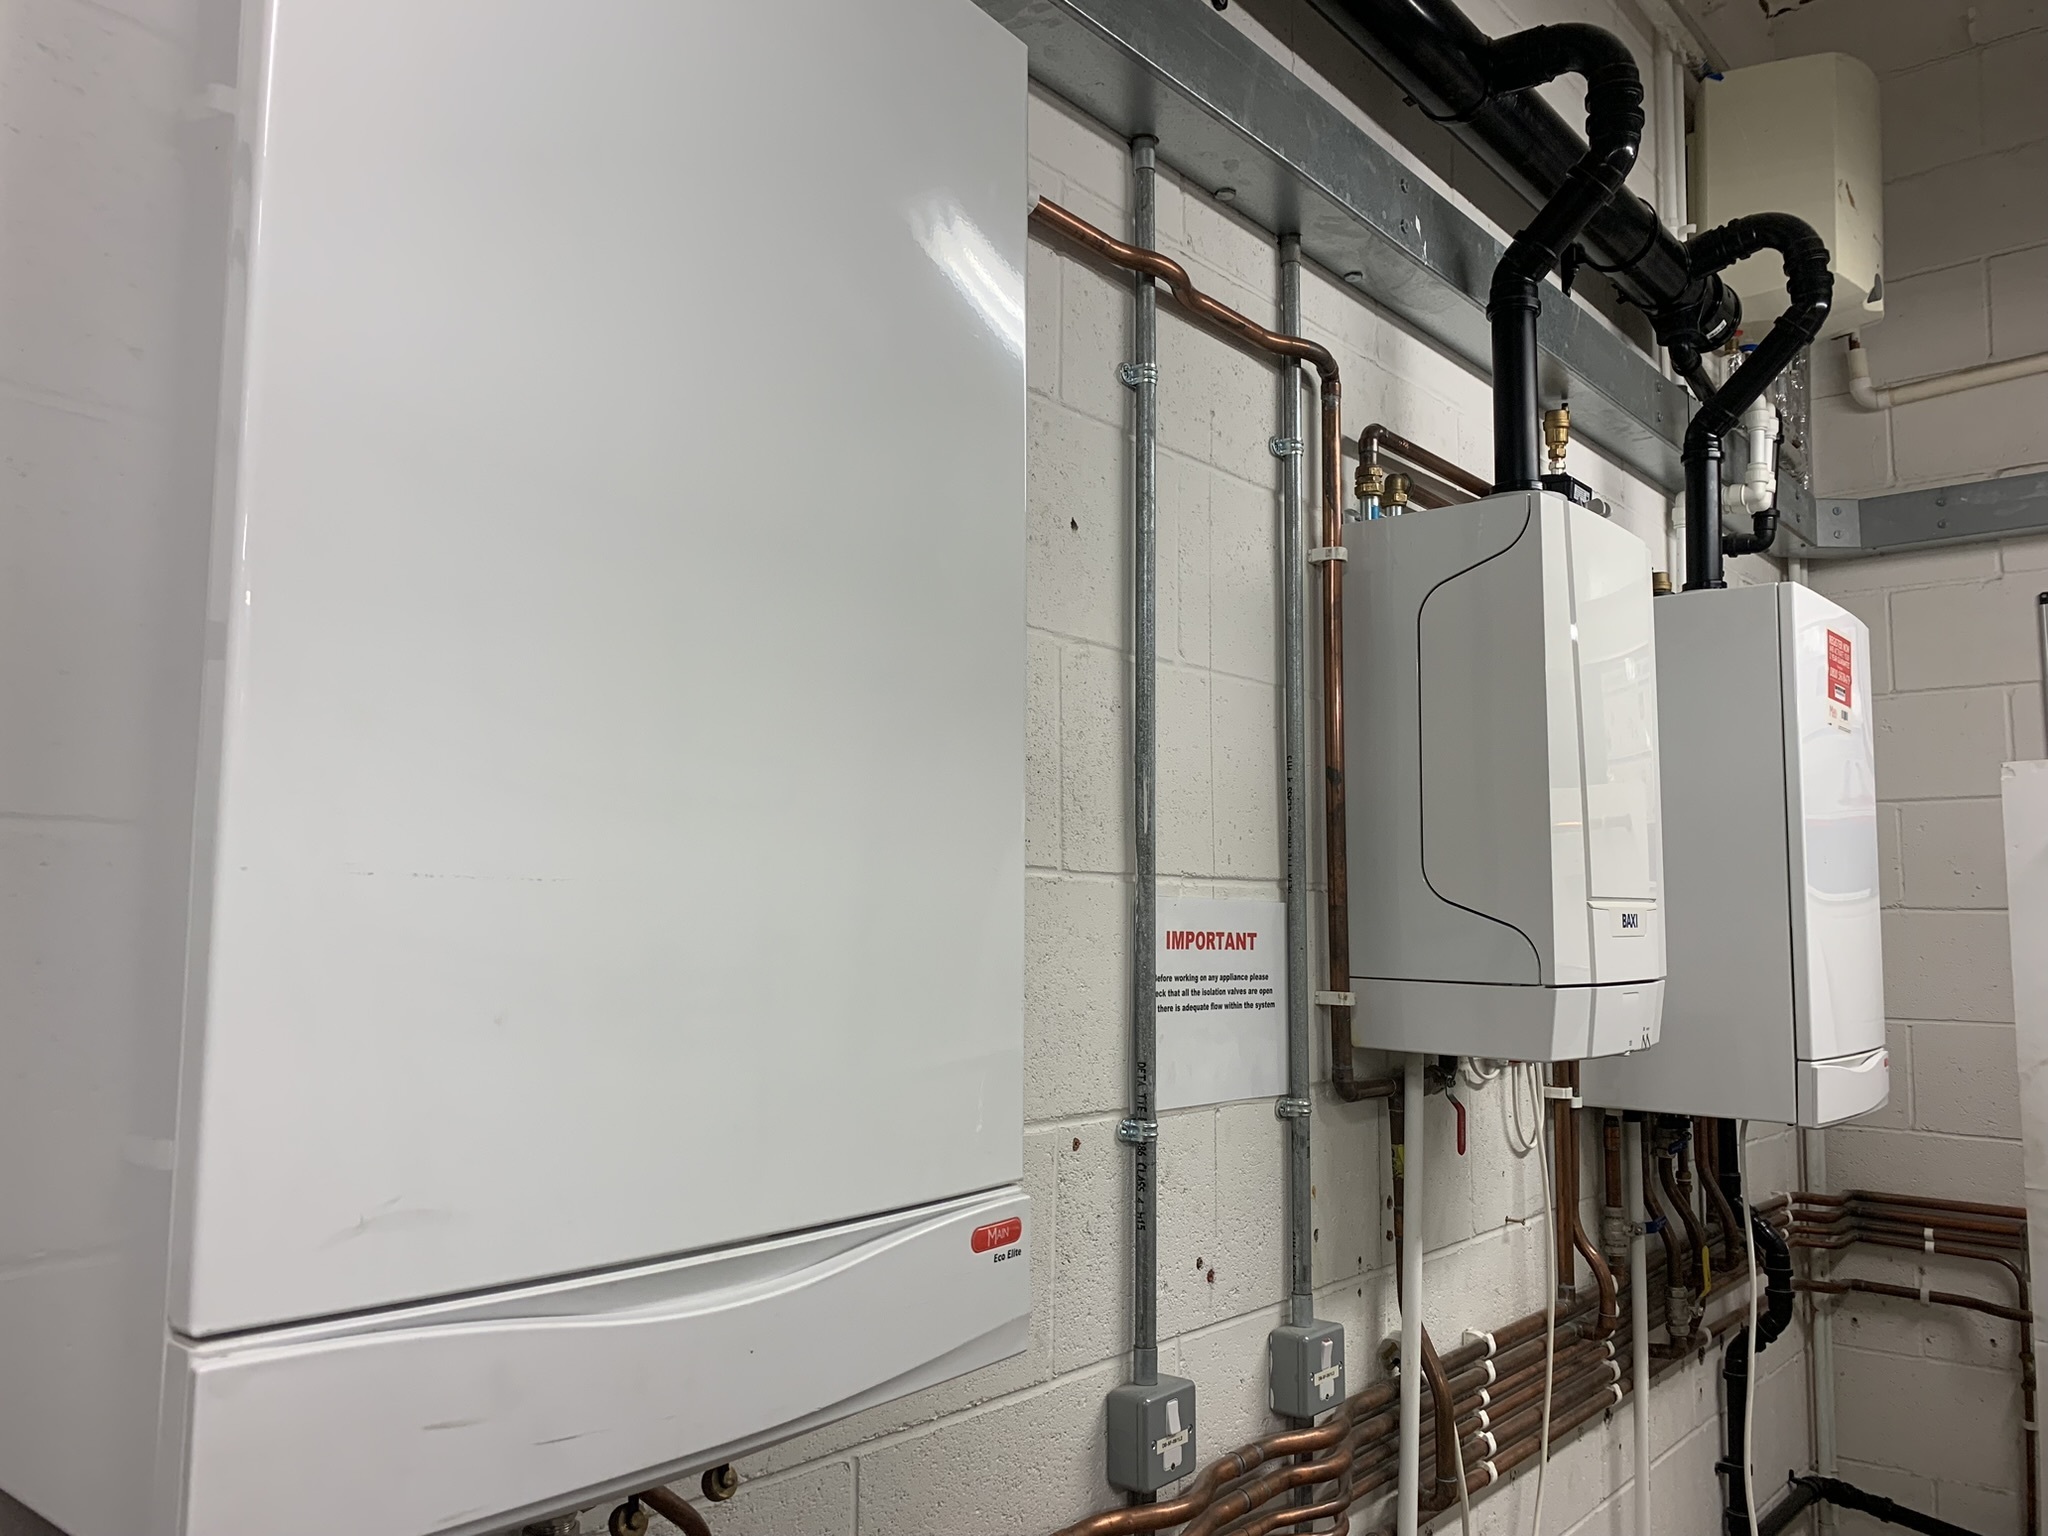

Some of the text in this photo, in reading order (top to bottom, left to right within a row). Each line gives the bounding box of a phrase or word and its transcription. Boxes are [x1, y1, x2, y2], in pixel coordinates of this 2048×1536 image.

[1622, 913, 1638, 928] BAXI
[1166, 930, 1257, 950] IMPORTANT
[1173, 974, 1199, 983] working
[1208, 975, 1219, 983] any
[1219, 972, 1249, 982] appliance
[1249, 972, 1269, 982] please
[1167, 989, 1180, 997] that
[1181, 988, 1190, 997] all
[1190, 988, 1201, 996] the
[1201, 987, 1227, 996] isolation
[1227, 987, 1247, 995] valves
[1258, 988, 1273, 996] open
[1157, 1001, 1276, 1013] there is adequate flow within the system
[1137, 1162, 1148, 1193] CLASS
[994, 1248, 1022, 1263] Eco Elite
